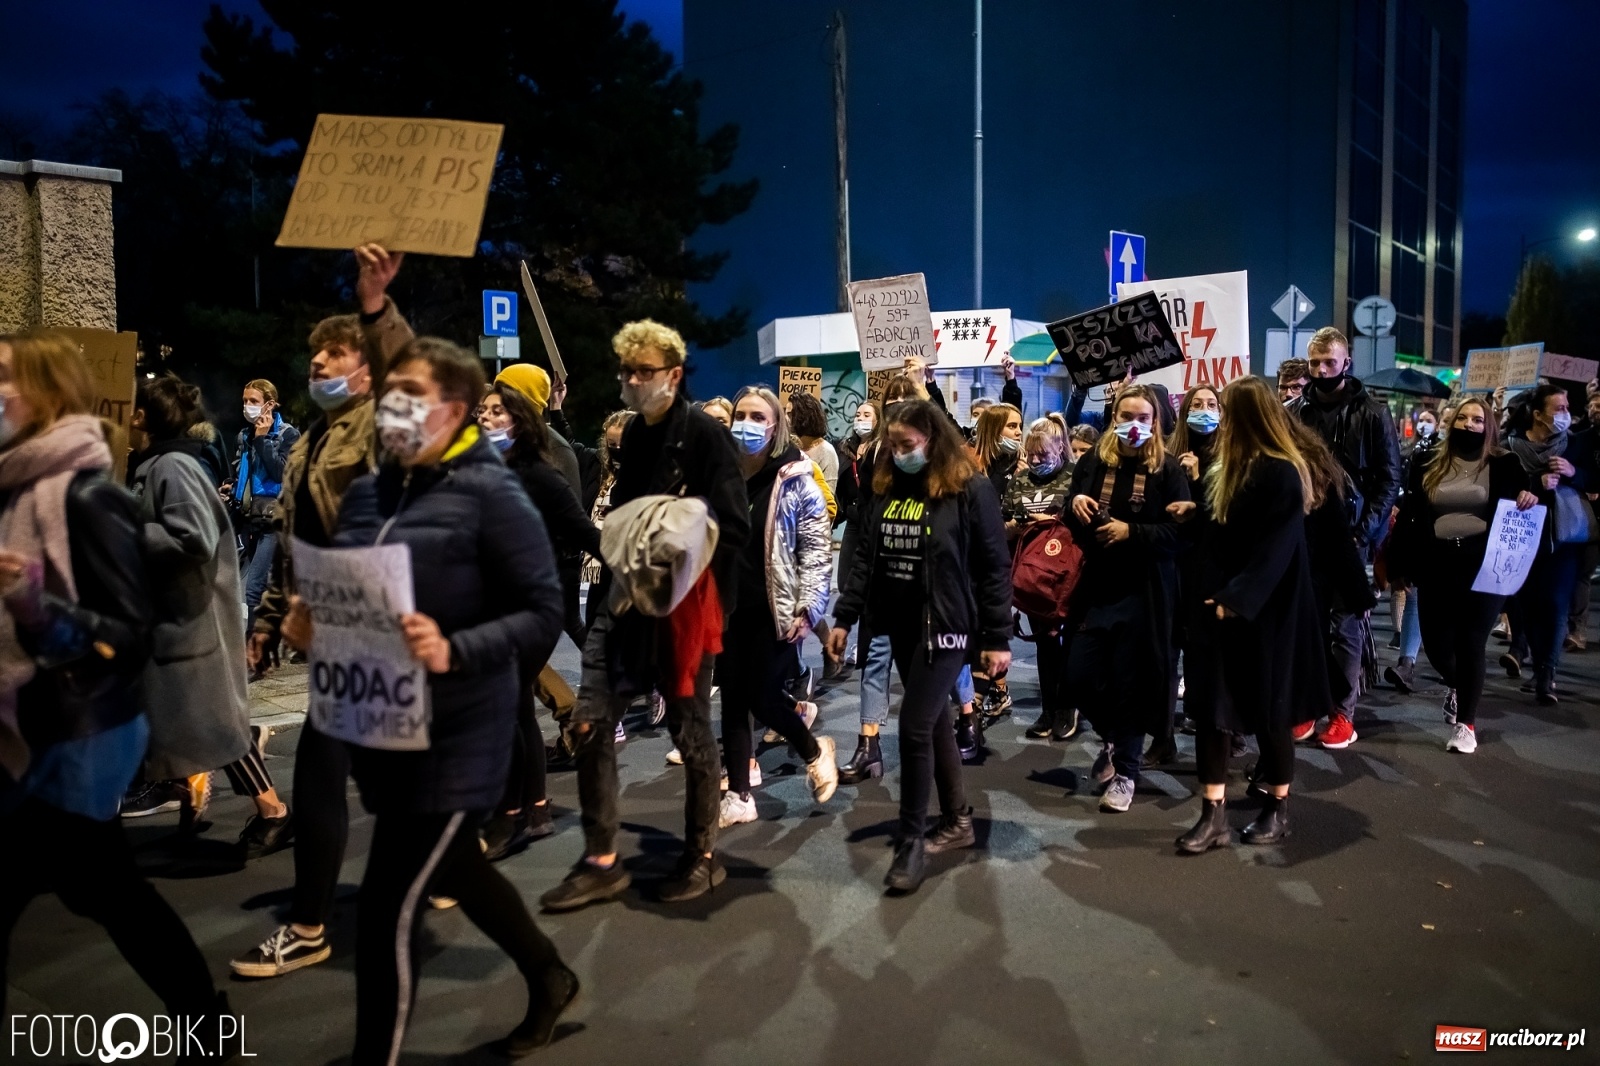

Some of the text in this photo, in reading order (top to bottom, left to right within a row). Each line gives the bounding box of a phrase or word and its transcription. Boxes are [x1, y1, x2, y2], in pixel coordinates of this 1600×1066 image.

[314, 121, 389, 148] MARS
[396, 123, 428, 148] OD
[307, 152, 338, 176] TO
[410, 155, 426, 179] A
[433, 157, 484, 193] PIS
[297, 181, 328, 204] OD
[389, 186, 457, 219] JEST
[856, 289, 922, 308] +48 222922
[491, 296, 511, 331] P
[886, 308, 910, 322] 597
[866, 326, 920, 344] ABORCJA
[1053, 298, 1158, 354] JESZCZE
[866, 347, 887, 360] BEZ
[782, 369, 822, 381] PIEKŁO
[1073, 367, 1103, 386] NIE
[780, 383, 817, 393] KOBIET
[937, 633, 968, 649] LOW
[314, 660, 416, 707] ODDAĆ
